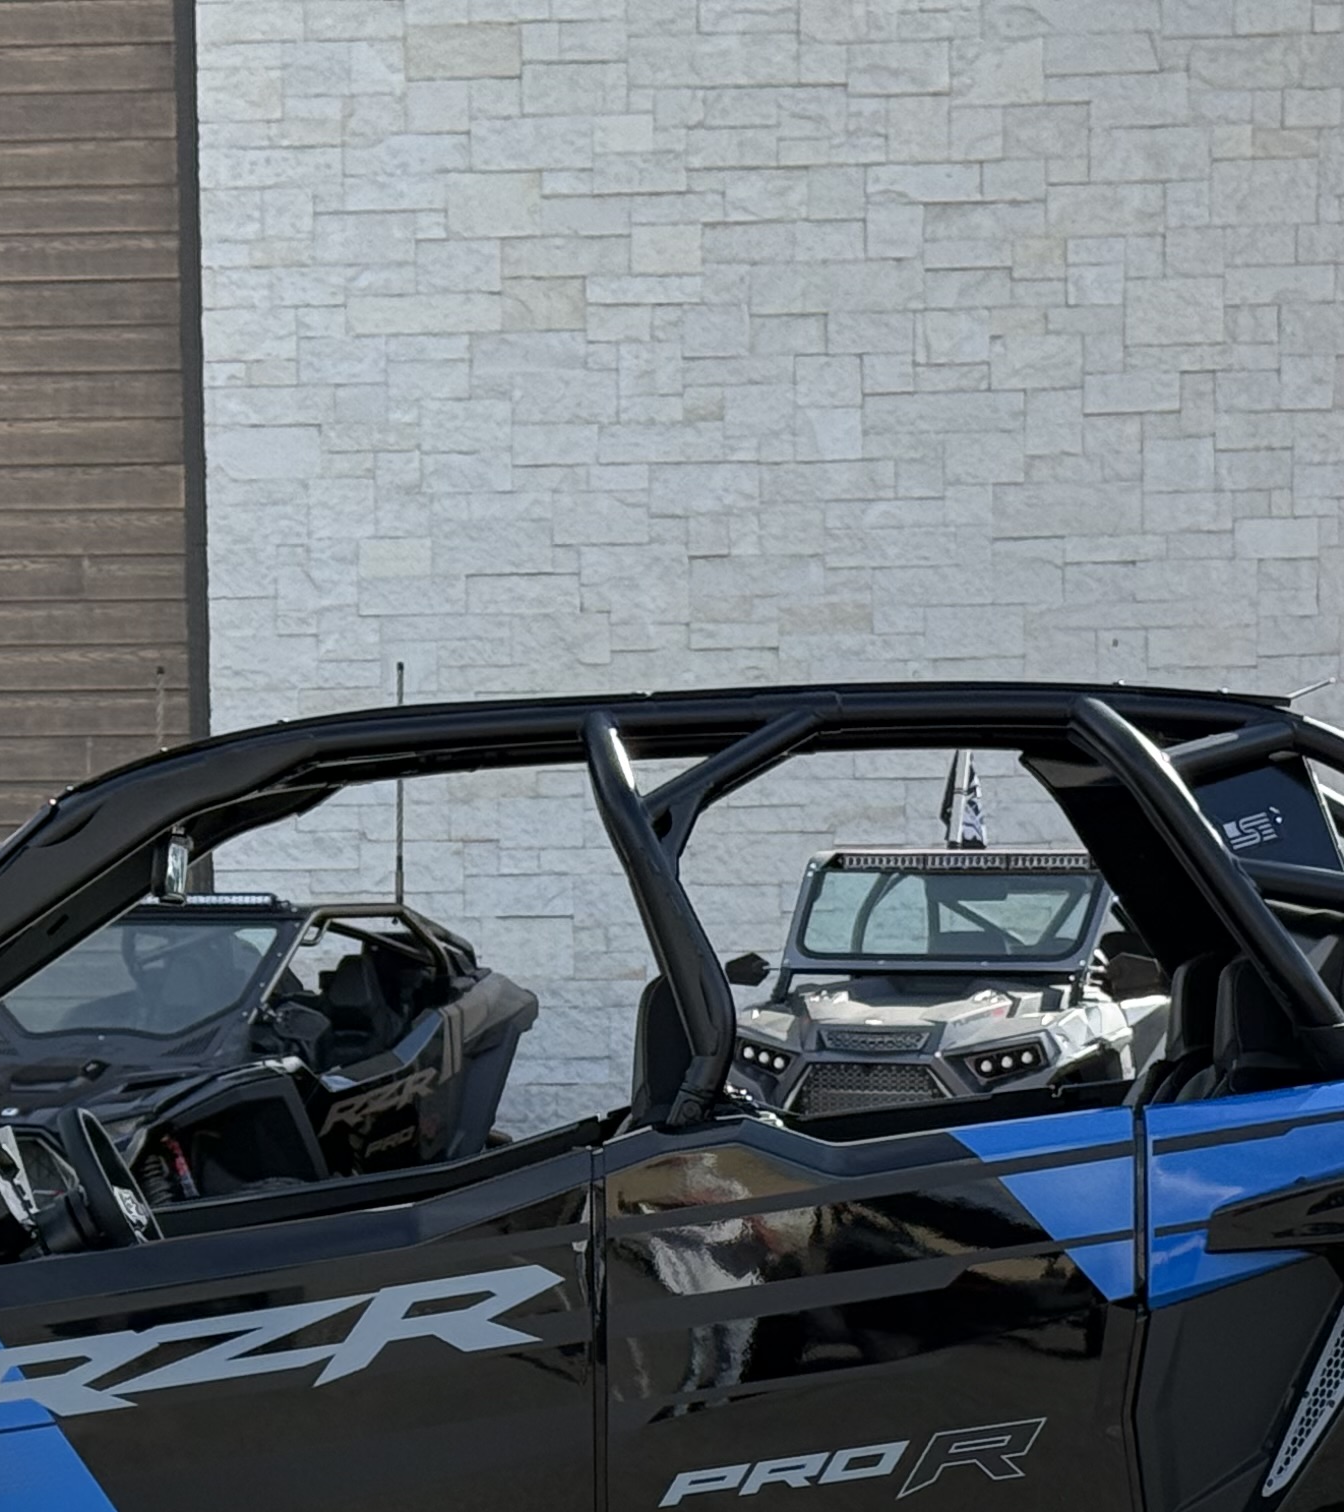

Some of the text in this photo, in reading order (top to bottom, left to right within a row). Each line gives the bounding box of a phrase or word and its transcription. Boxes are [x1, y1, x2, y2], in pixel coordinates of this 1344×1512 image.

[317, 1067, 437, 1138] RZR
[658, 1417, 1048, 1508] PRO R
